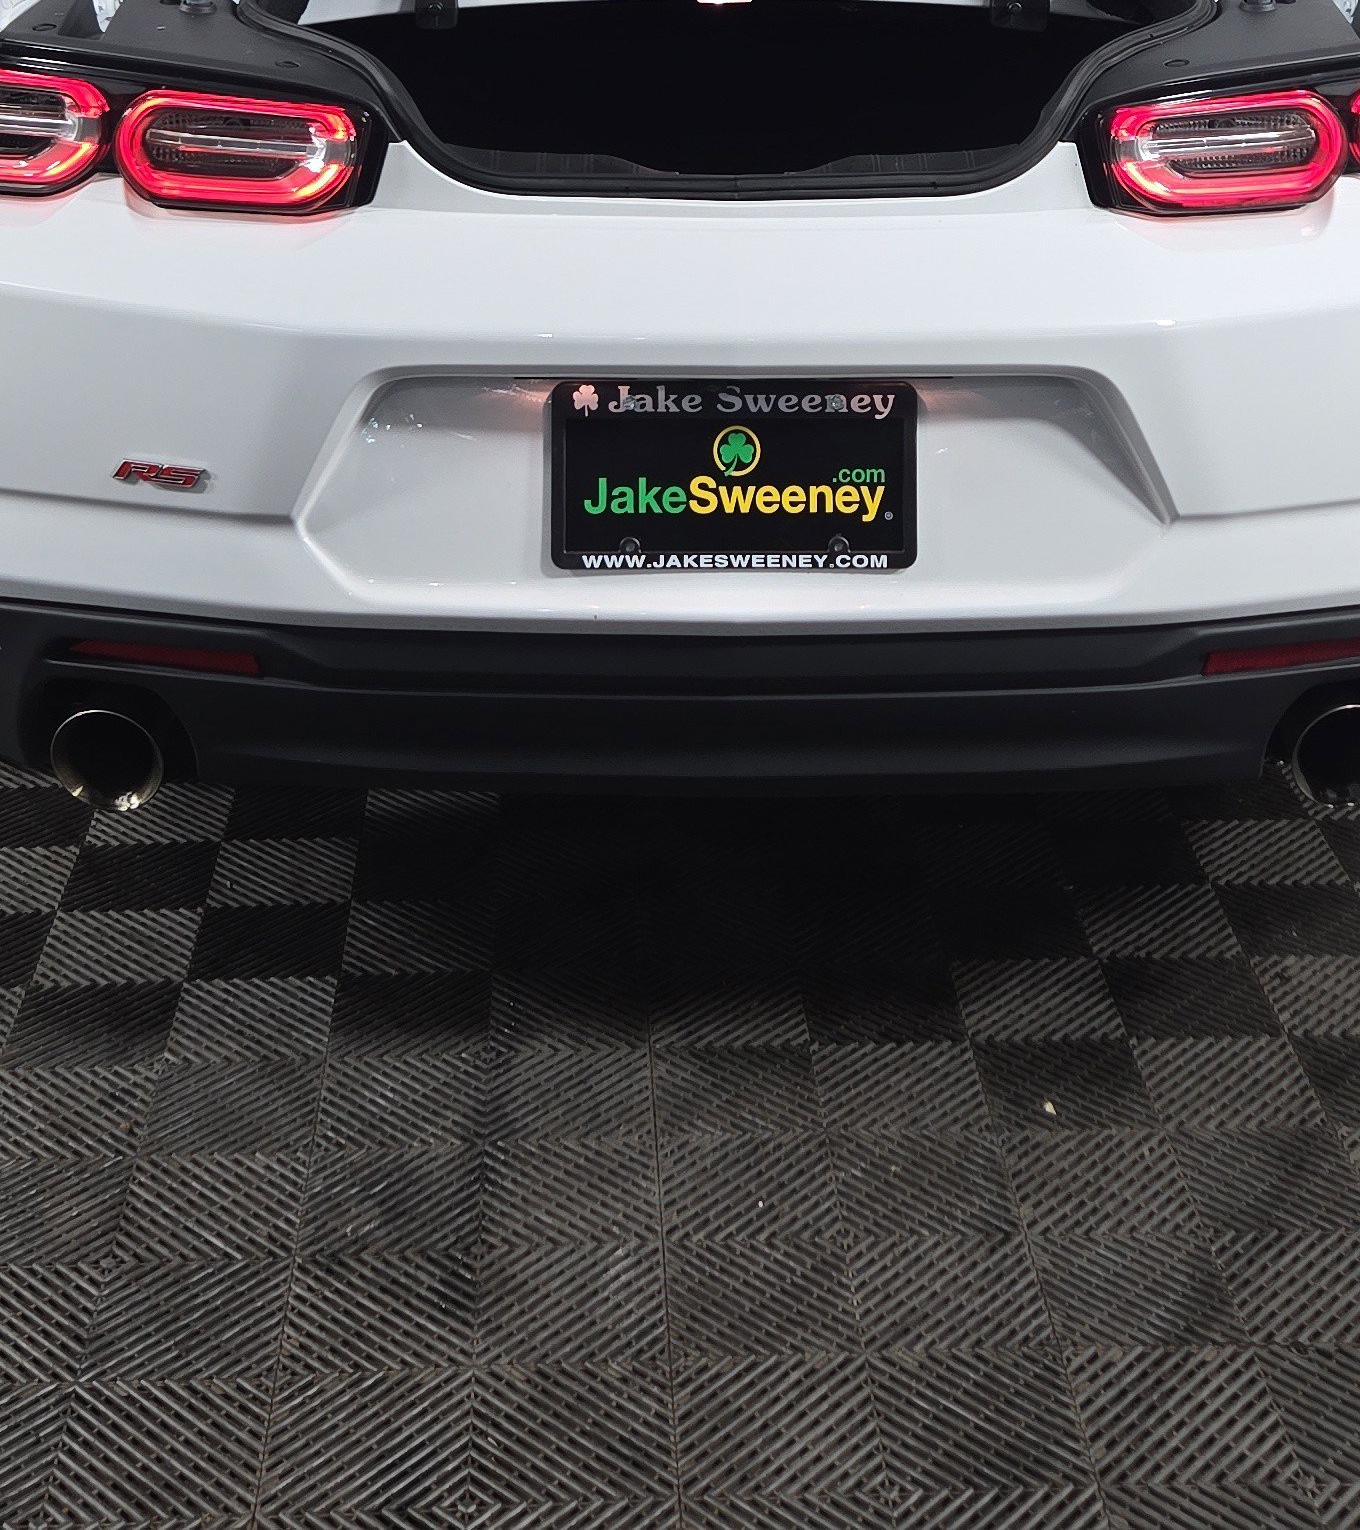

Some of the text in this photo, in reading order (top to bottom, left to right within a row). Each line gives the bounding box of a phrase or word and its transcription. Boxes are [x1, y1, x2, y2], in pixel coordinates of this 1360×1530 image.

[606, 384, 896, 420] Jake Sweeney
[112, 458, 206, 488] RS
[831, 466, 886, 484] .com
[581, 553, 889, 570] WWW.JAKESWEENEY.COM
